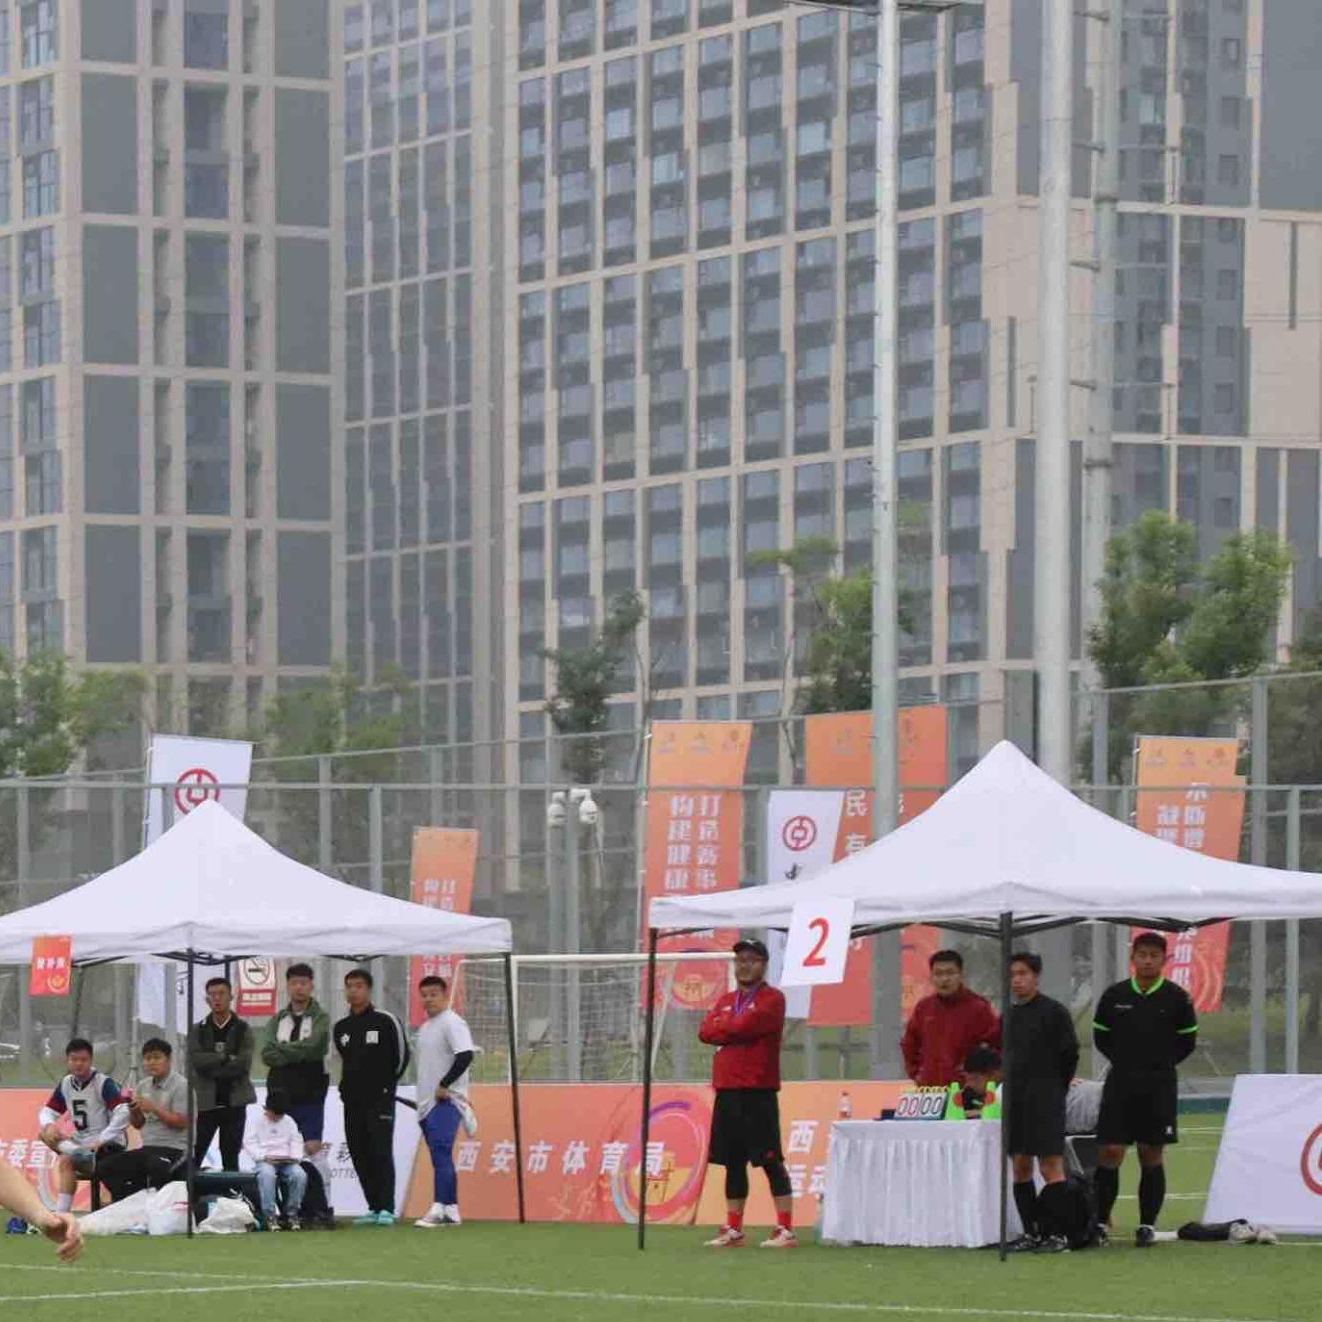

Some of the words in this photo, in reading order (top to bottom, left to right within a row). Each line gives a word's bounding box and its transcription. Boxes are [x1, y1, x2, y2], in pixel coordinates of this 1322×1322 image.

[802, 917, 830, 967] 2
[72, 1099, 89, 1131] 5
[456, 1141, 665, 1176] 西安市体育局
